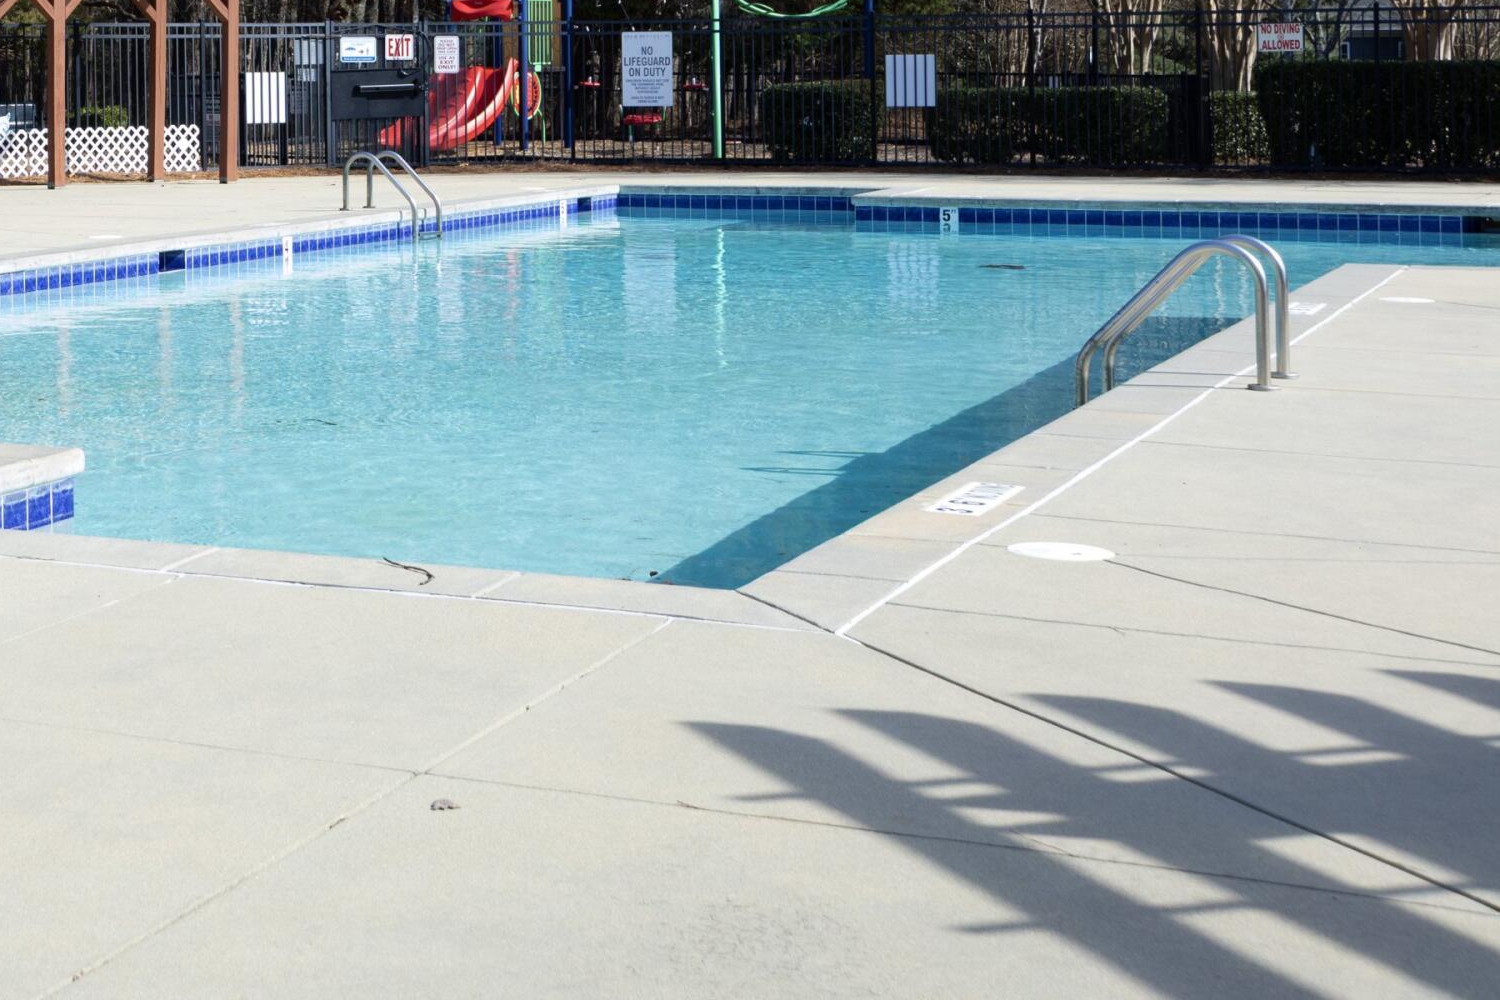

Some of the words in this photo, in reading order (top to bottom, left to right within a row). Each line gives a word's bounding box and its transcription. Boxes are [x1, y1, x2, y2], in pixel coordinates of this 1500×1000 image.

[1260, 24, 1272, 34] NO
[1273, 23, 1300, 34] DIVING
[388, 37, 411, 57] EXIT
[1261, 39, 1301, 50] ALLOWED
[640, 46, 653, 56] NO
[623, 56, 671, 67] LIFEGUARD
[628, 67, 641, 77] ON
[643, 67, 666, 77] DUTY
[942, 209, 951, 222] 5
